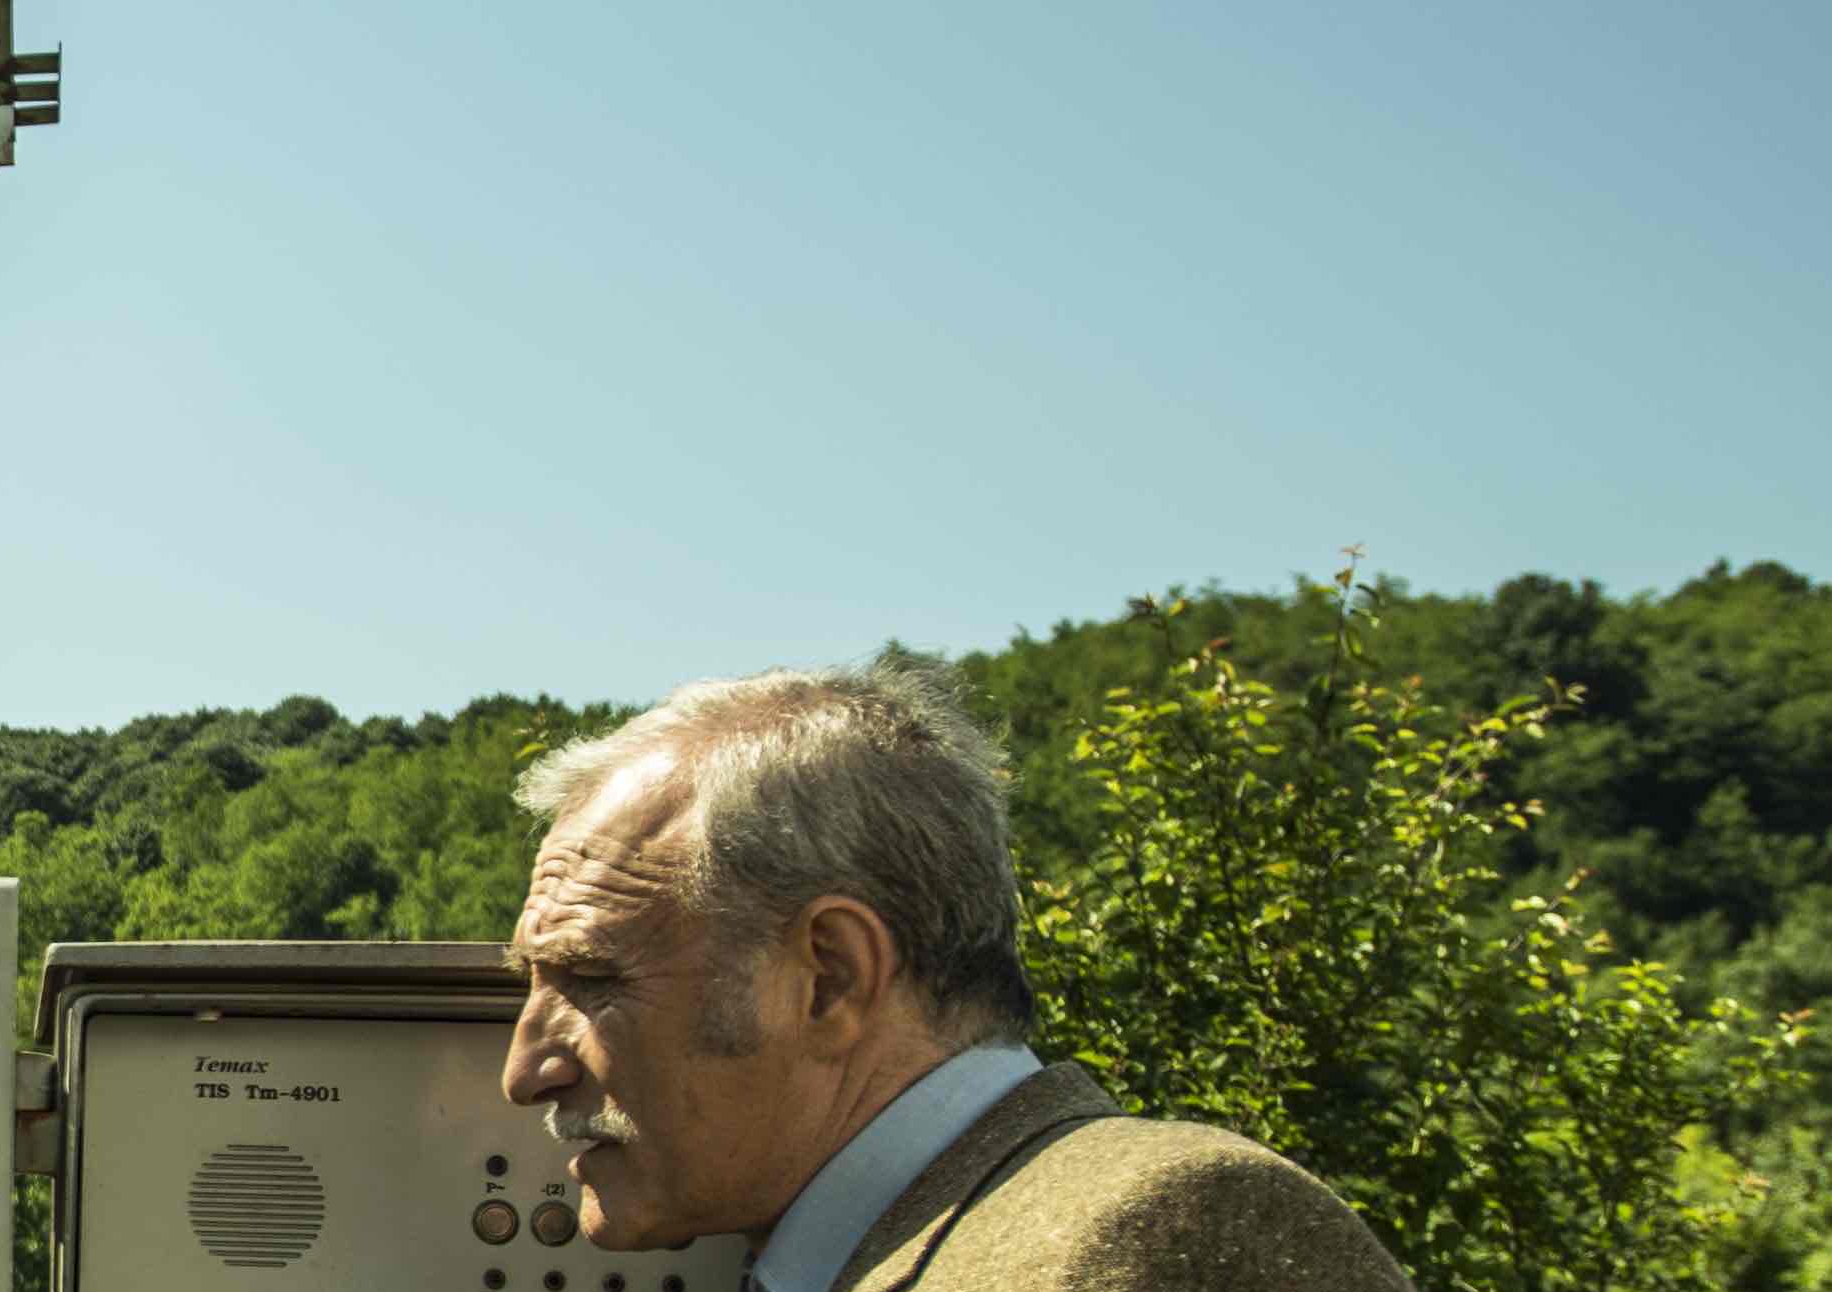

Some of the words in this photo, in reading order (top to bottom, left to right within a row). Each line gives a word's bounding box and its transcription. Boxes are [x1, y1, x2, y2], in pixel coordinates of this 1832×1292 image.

[194, 1056, 270, 1074] Temax
[194, 1083, 230, 1099] TIS
[245, 1085, 341, 1102] Tm-4901
